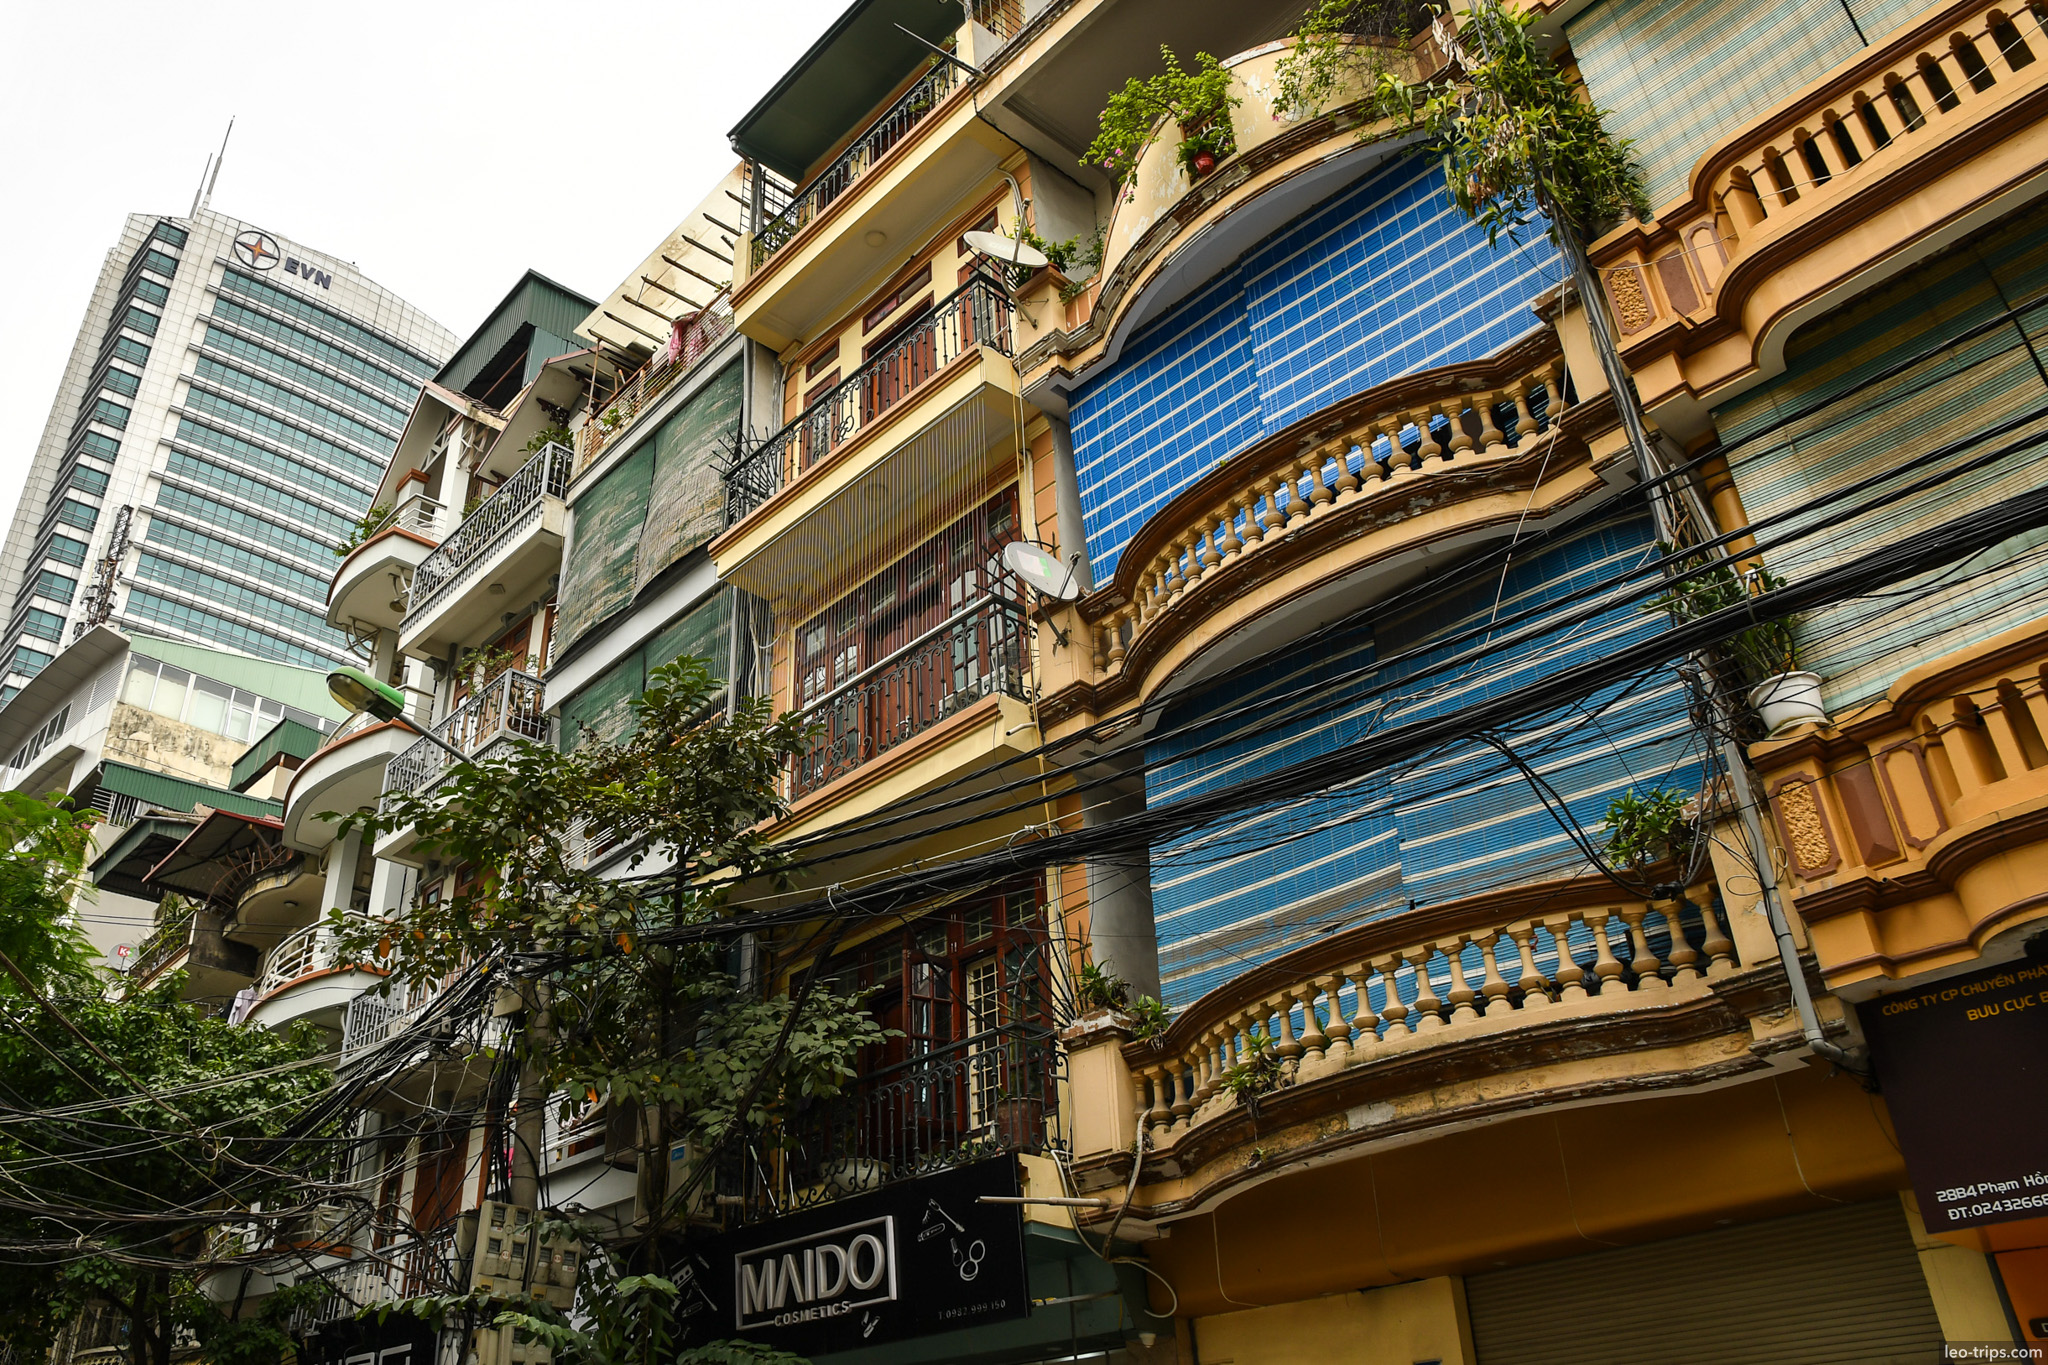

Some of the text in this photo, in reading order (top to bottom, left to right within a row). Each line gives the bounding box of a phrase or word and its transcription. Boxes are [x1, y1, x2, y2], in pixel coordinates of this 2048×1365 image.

[284, 256, 332, 290] EVN
[1882, 998, 1919, 1016] CÔNG
[1920, 993, 1938, 1007] TY
[1940, 988, 1959, 1002] CP
[1966, 1003, 2000, 1021] BƯU
[2003, 994, 2037, 1012] CỤC
[1936, 1185, 1978, 1202] 28B4
[1977, 1180, 2020, 1195] Phạm
[741, 1233, 885, 1315] MAIDO
[774, 1300, 851, 1327] COSMETICS
